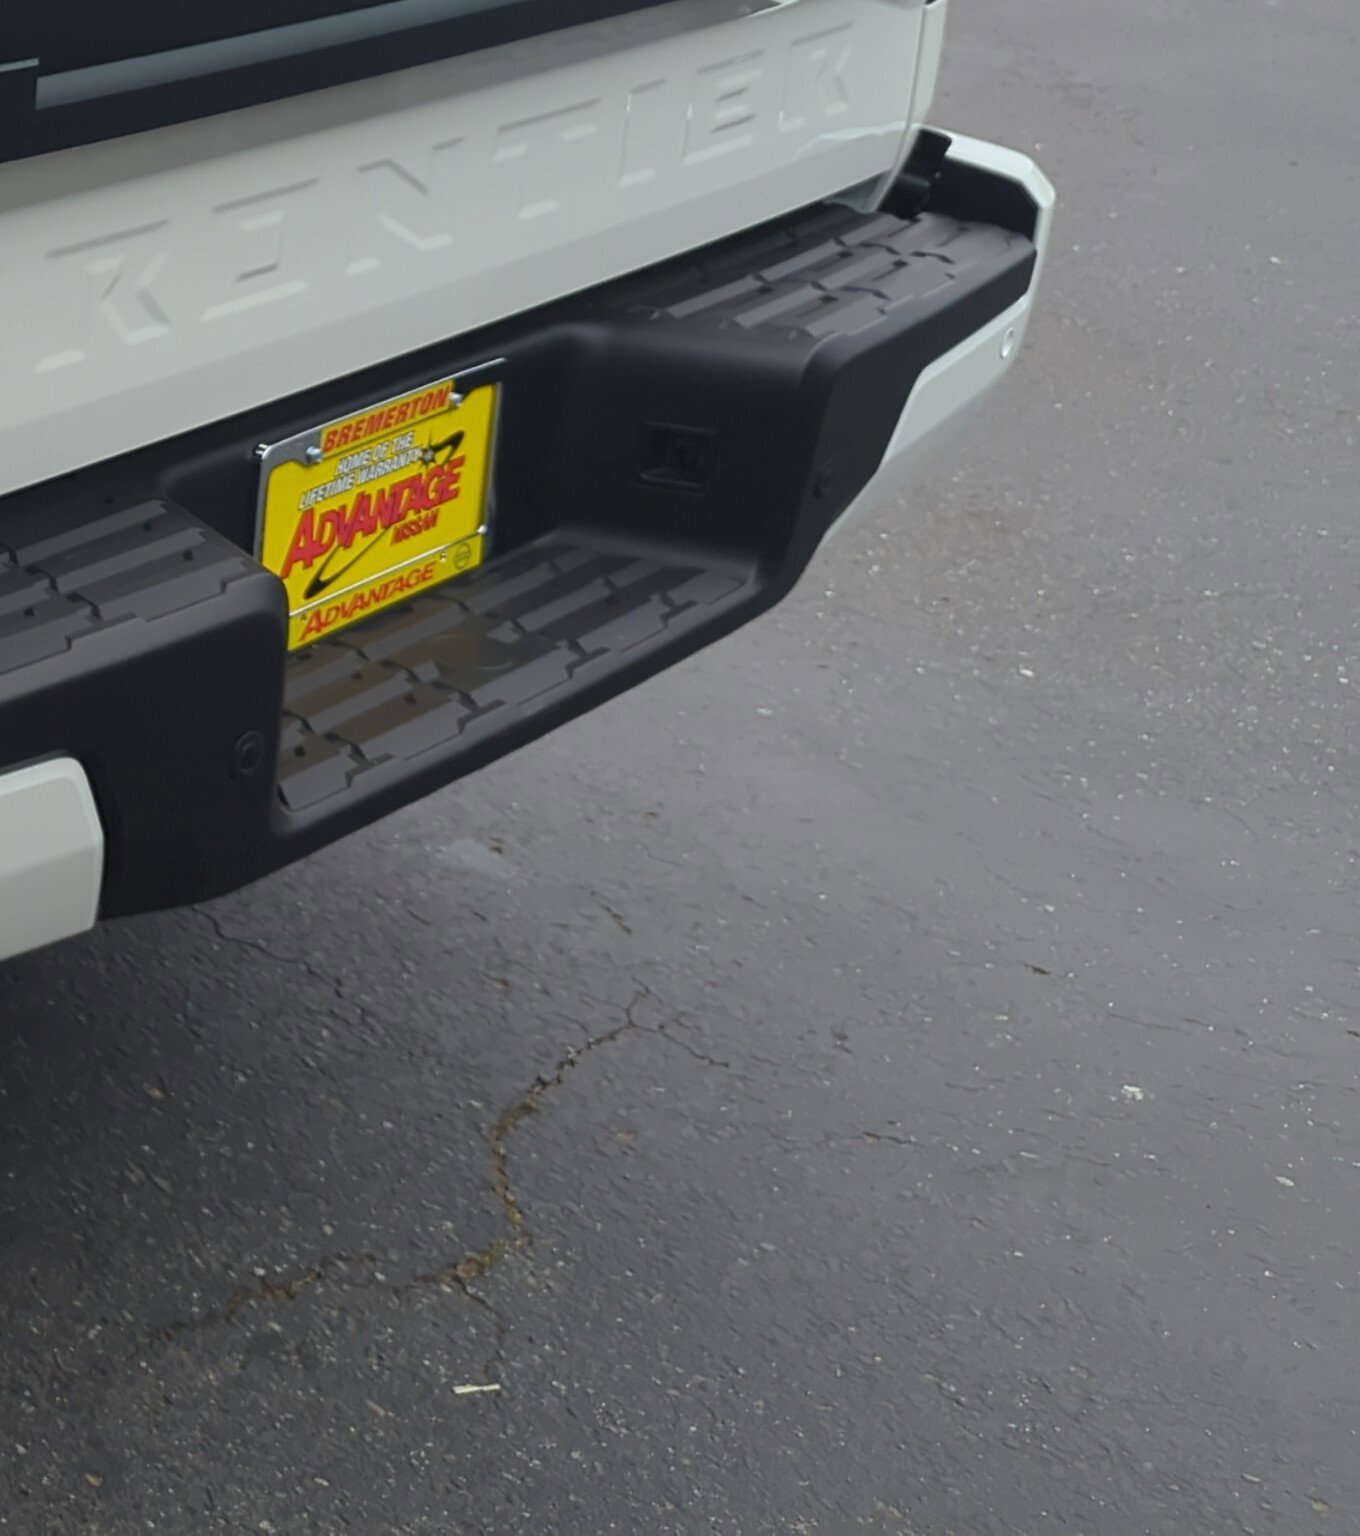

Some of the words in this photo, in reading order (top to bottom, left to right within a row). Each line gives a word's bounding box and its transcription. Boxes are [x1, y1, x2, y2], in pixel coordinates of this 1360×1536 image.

[323, 384, 452, 452] BREMERTON
[298, 472, 355, 510] LIFETIME
[357, 447, 423, 485] WARRANTY
[336, 448, 371, 475] HOME
[372, 441, 390, 461] OF
[393, 431, 414, 452] THE
[281, 455, 465, 579] ADVANTAGE
[298, 560, 437, 642] ADVANTAGE
